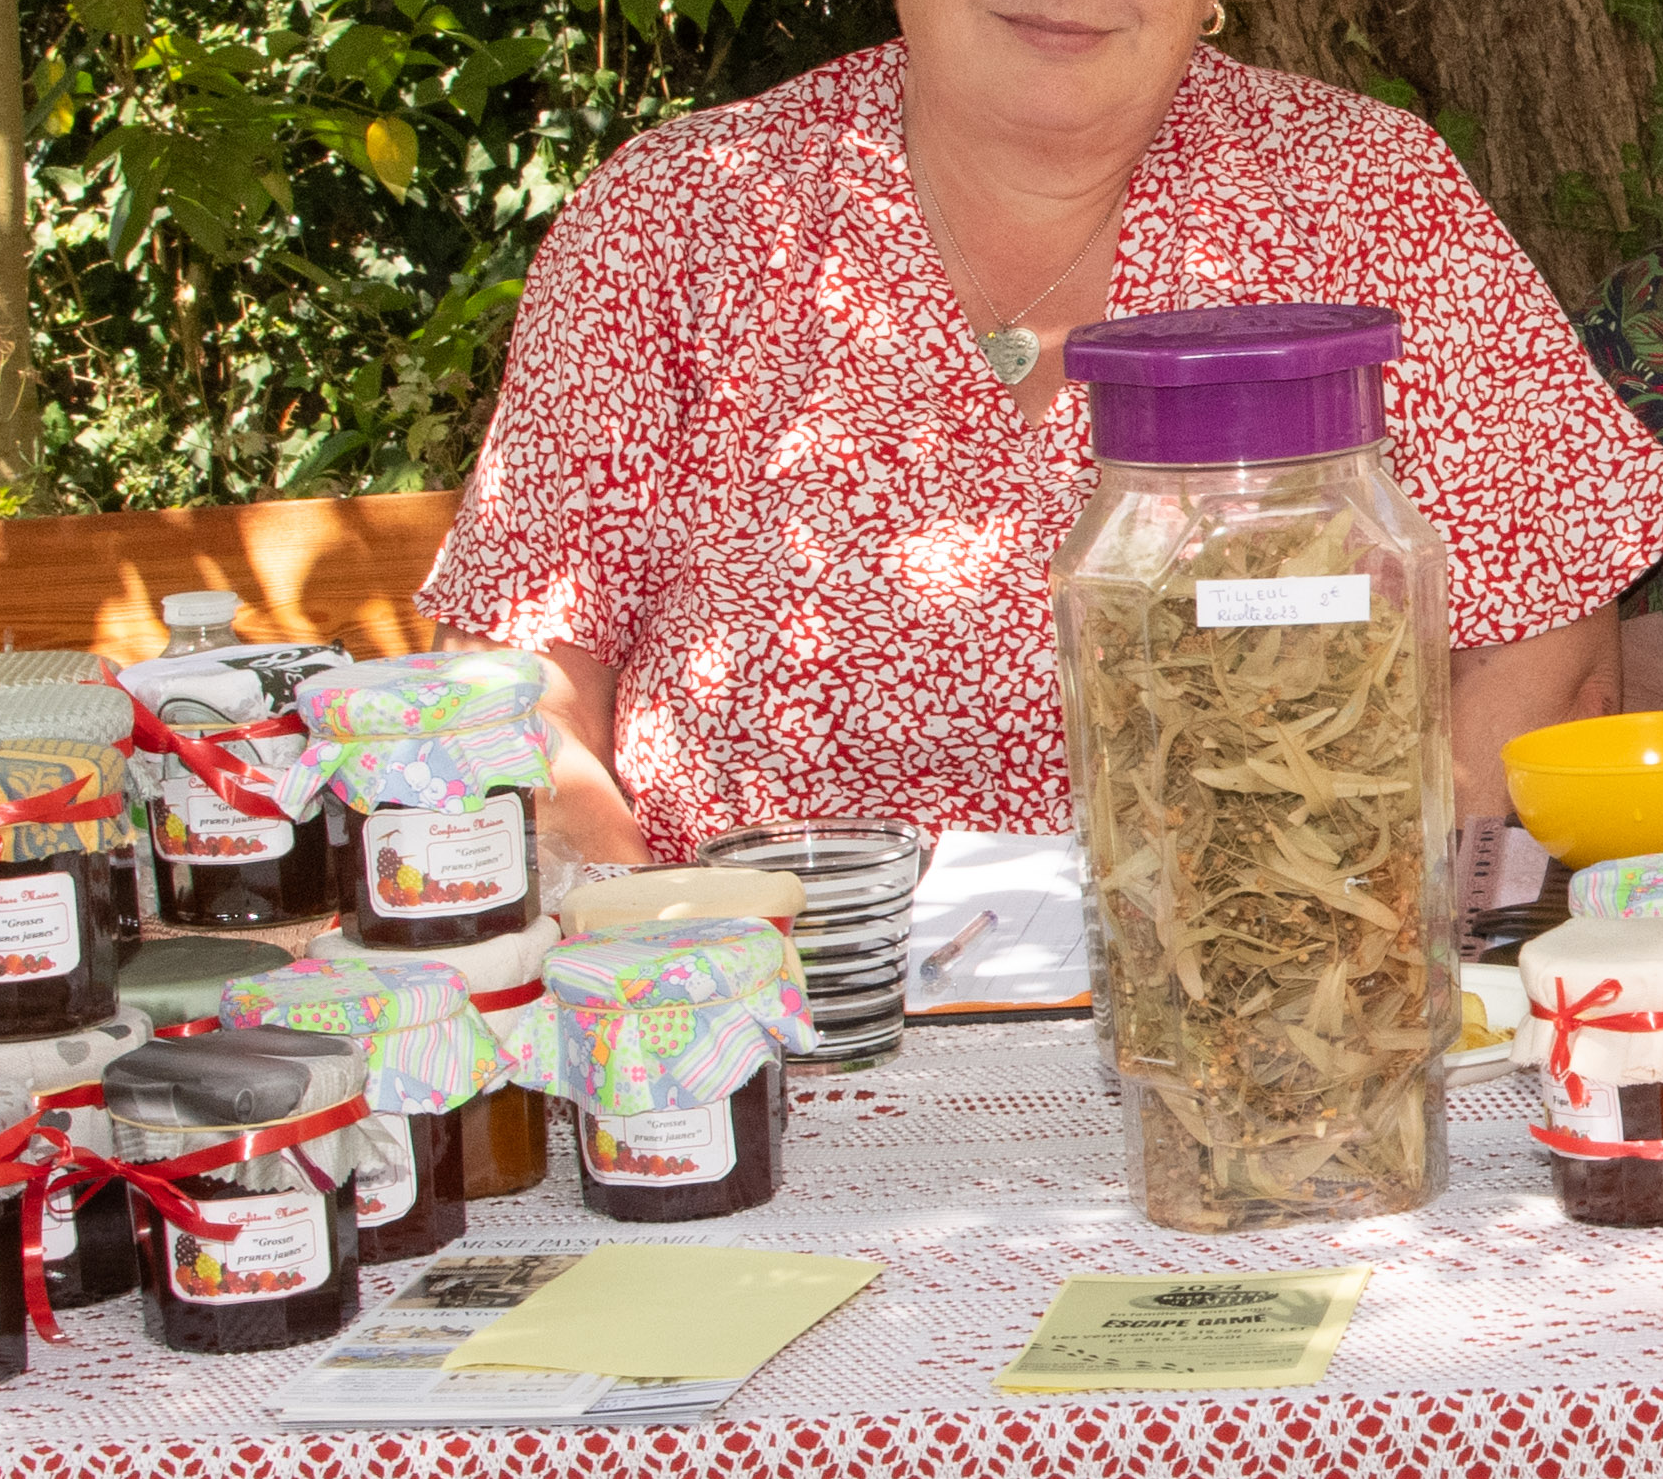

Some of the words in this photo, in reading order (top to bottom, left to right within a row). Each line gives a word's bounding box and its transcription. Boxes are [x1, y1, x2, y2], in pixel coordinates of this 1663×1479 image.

[1209, 586, 1289, 603] TILLEUL
[20, 889, 60, 903] Maison
[228, 1212, 272, 1226] Confiture
[1169, 1284, 1244, 1293] 2024
[433, 1310, 457, 1318] de
[464, 1309, 508, 1317] Vivr
[1101, 1319, 1190, 1329] ESCAPE
[1197, 1313, 1267, 1327] GAME
